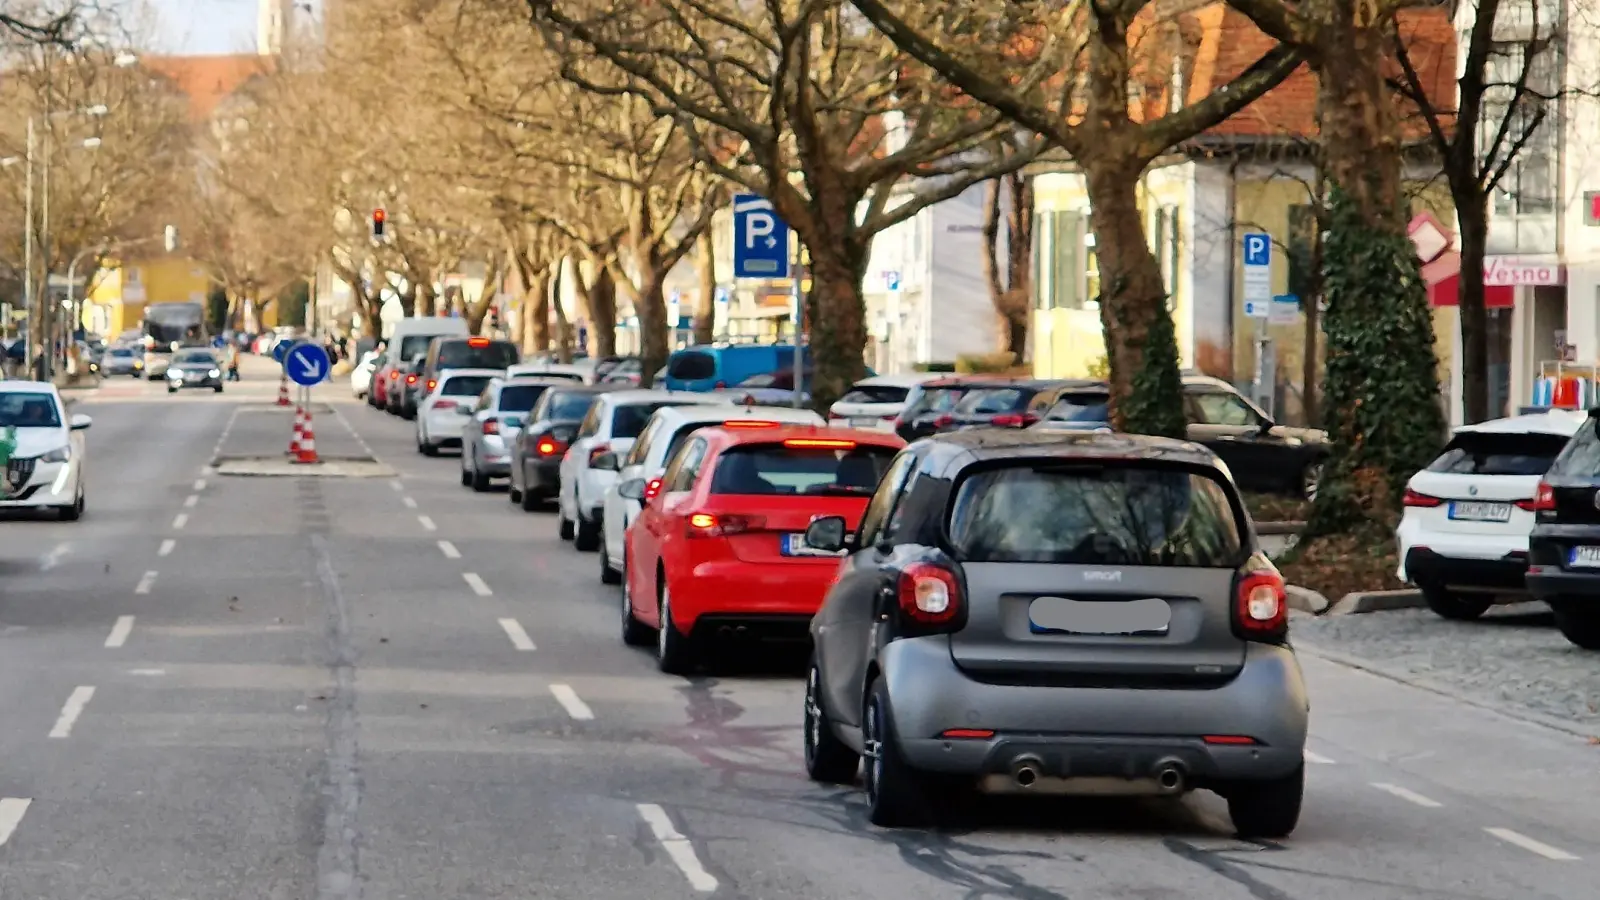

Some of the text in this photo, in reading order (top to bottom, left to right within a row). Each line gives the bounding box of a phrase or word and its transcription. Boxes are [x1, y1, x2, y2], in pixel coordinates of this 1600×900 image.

[746, 213, 775, 248] P
[1249, 237, 1264, 261] P
[1483, 258, 1551, 281] Vesna
[1083, 570, 1121, 582] smart
